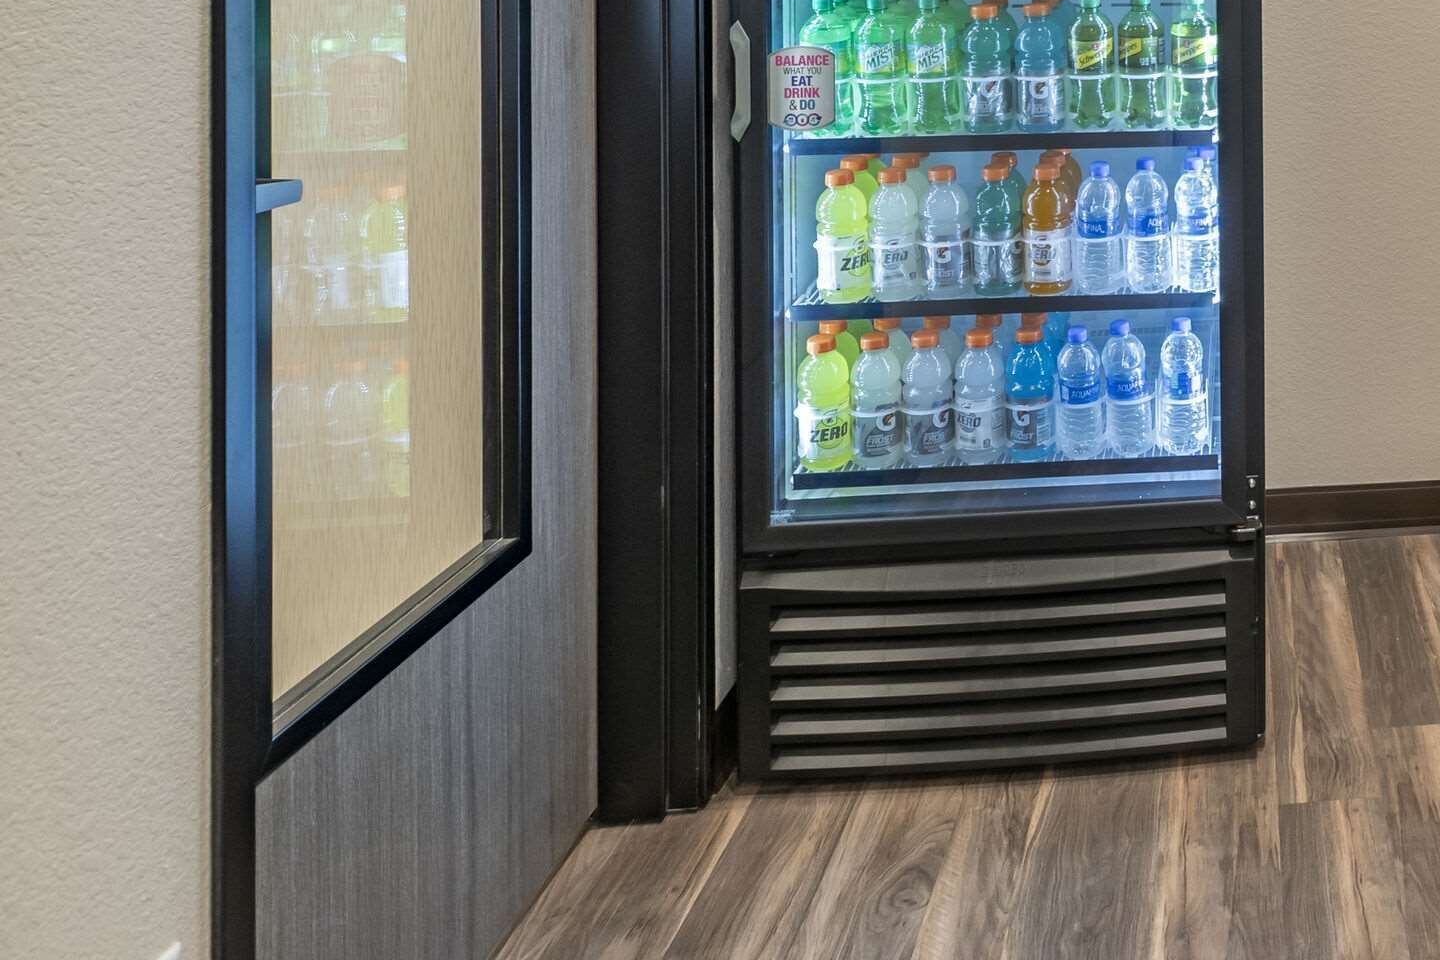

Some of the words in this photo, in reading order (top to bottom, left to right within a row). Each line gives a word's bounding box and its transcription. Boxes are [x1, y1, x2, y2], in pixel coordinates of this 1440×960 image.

[775, 54, 830, 66] BALANCE
[783, 67, 804, 75] WHAT
[791, 75, 813, 87] EAT
[783, 87, 821, 99] DRINK
[789, 99, 797, 111] &
[800, 99, 815, 110] DO
[810, 421, 849, 445] ZERO
